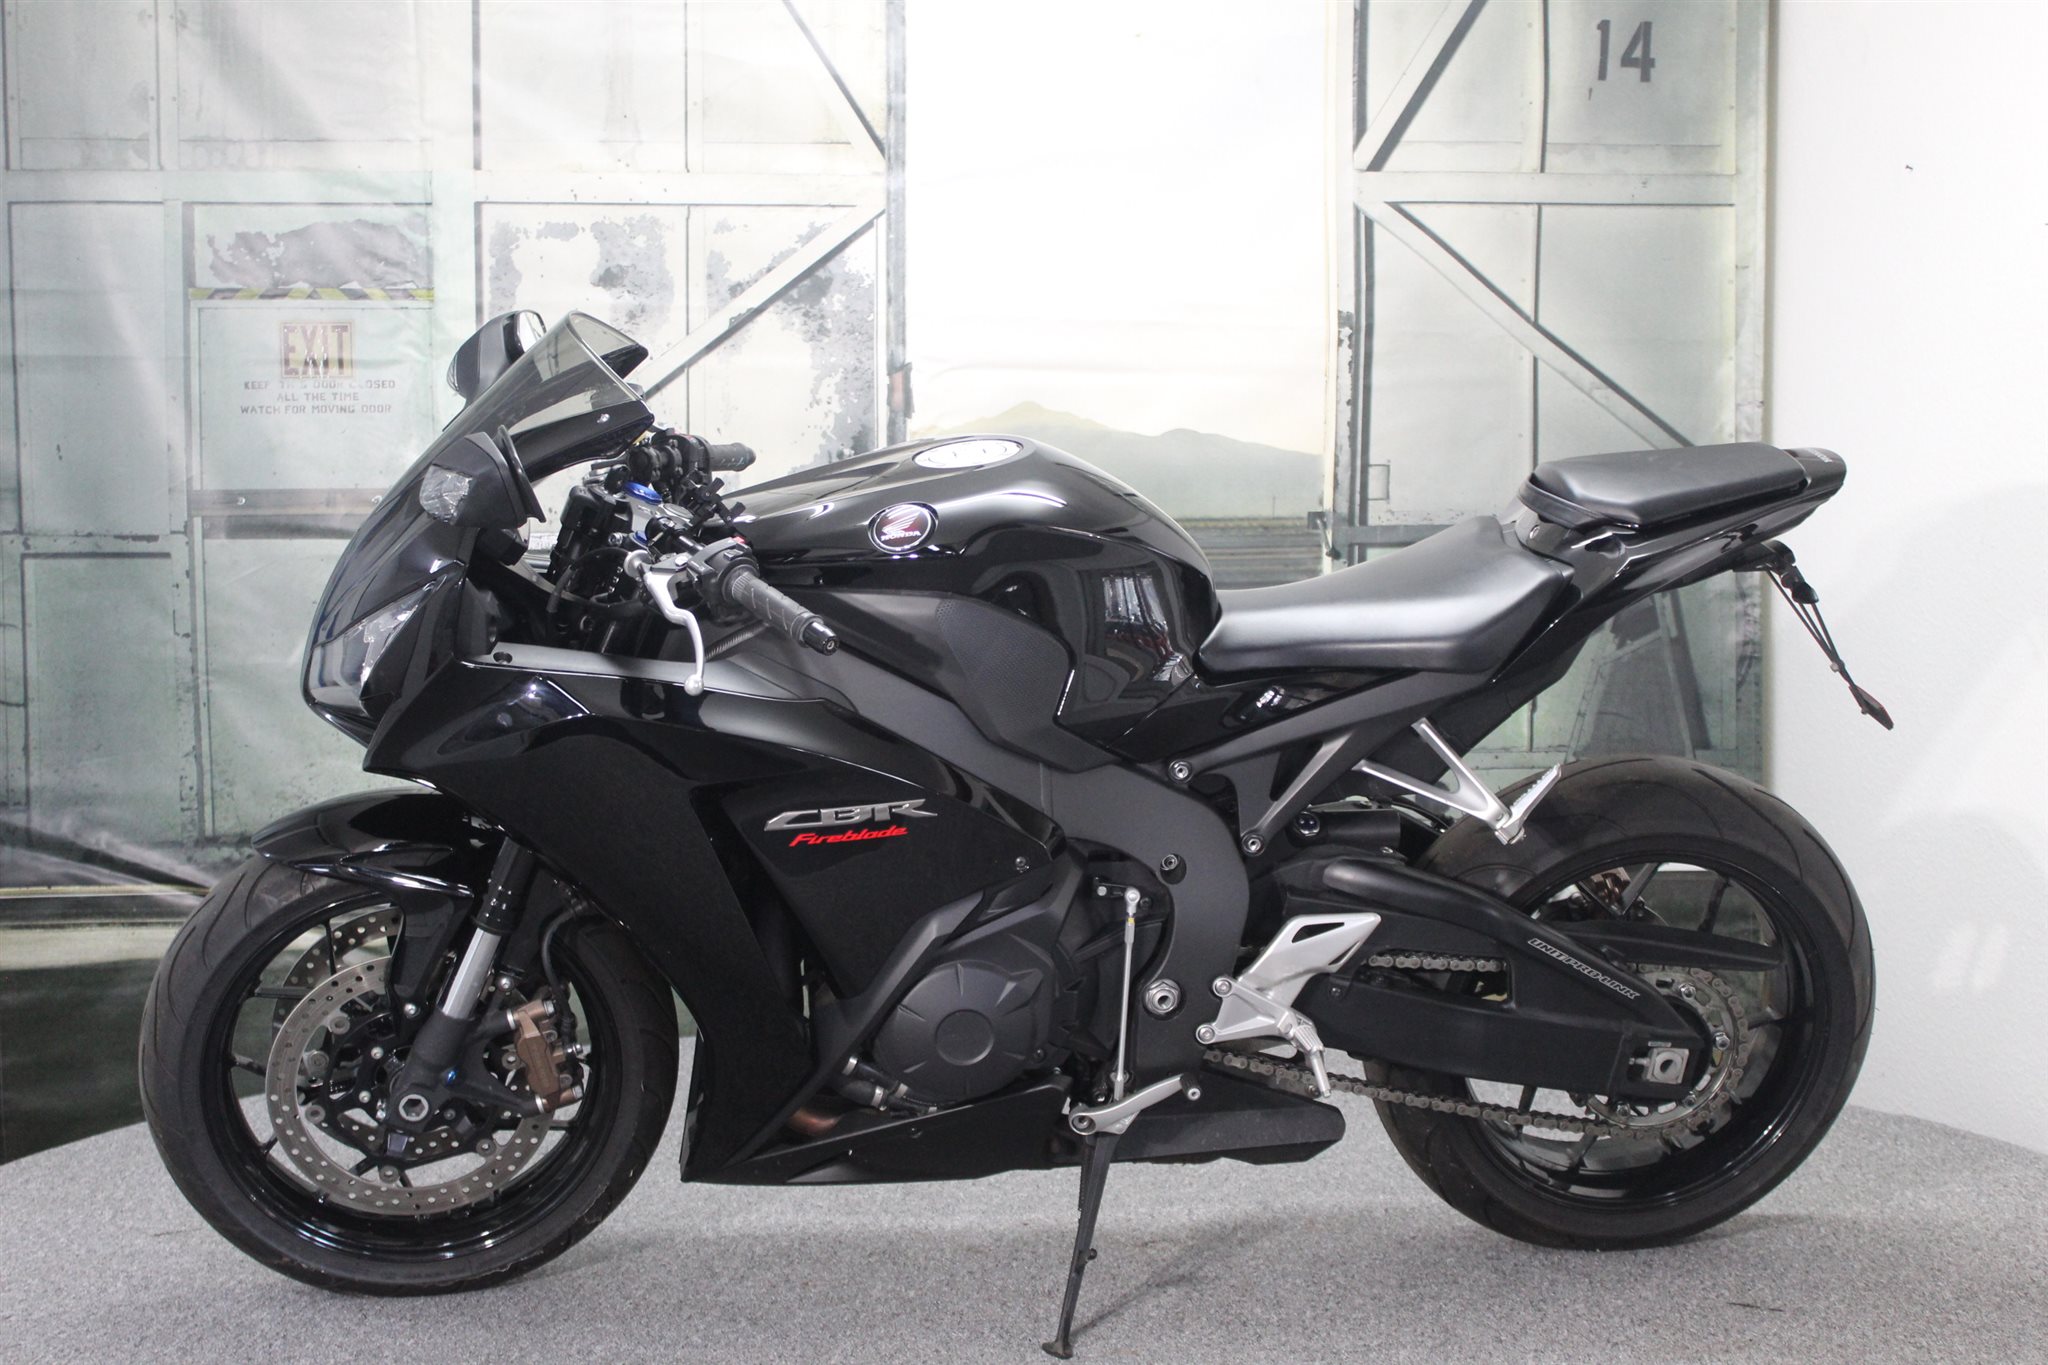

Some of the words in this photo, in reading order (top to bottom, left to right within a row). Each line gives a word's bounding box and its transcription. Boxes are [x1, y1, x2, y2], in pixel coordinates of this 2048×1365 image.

[1597, 19, 1656, 83] 14
[283, 324, 349, 376] EXIT
[277, 392, 298, 401] ALL
[304, 392, 326, 401] THE
[331, 392, 359, 401] TIME
[240, 405, 280, 415] WATCH
[284, 405, 306, 415] FOR
[311, 404, 355, 414] MOVING
[361, 404, 392, 414] DOOR
[764, 798, 938, 831] CBR
[789, 825, 908, 847] Fireblade
[1527, 938, 1569, 963] UNIT
